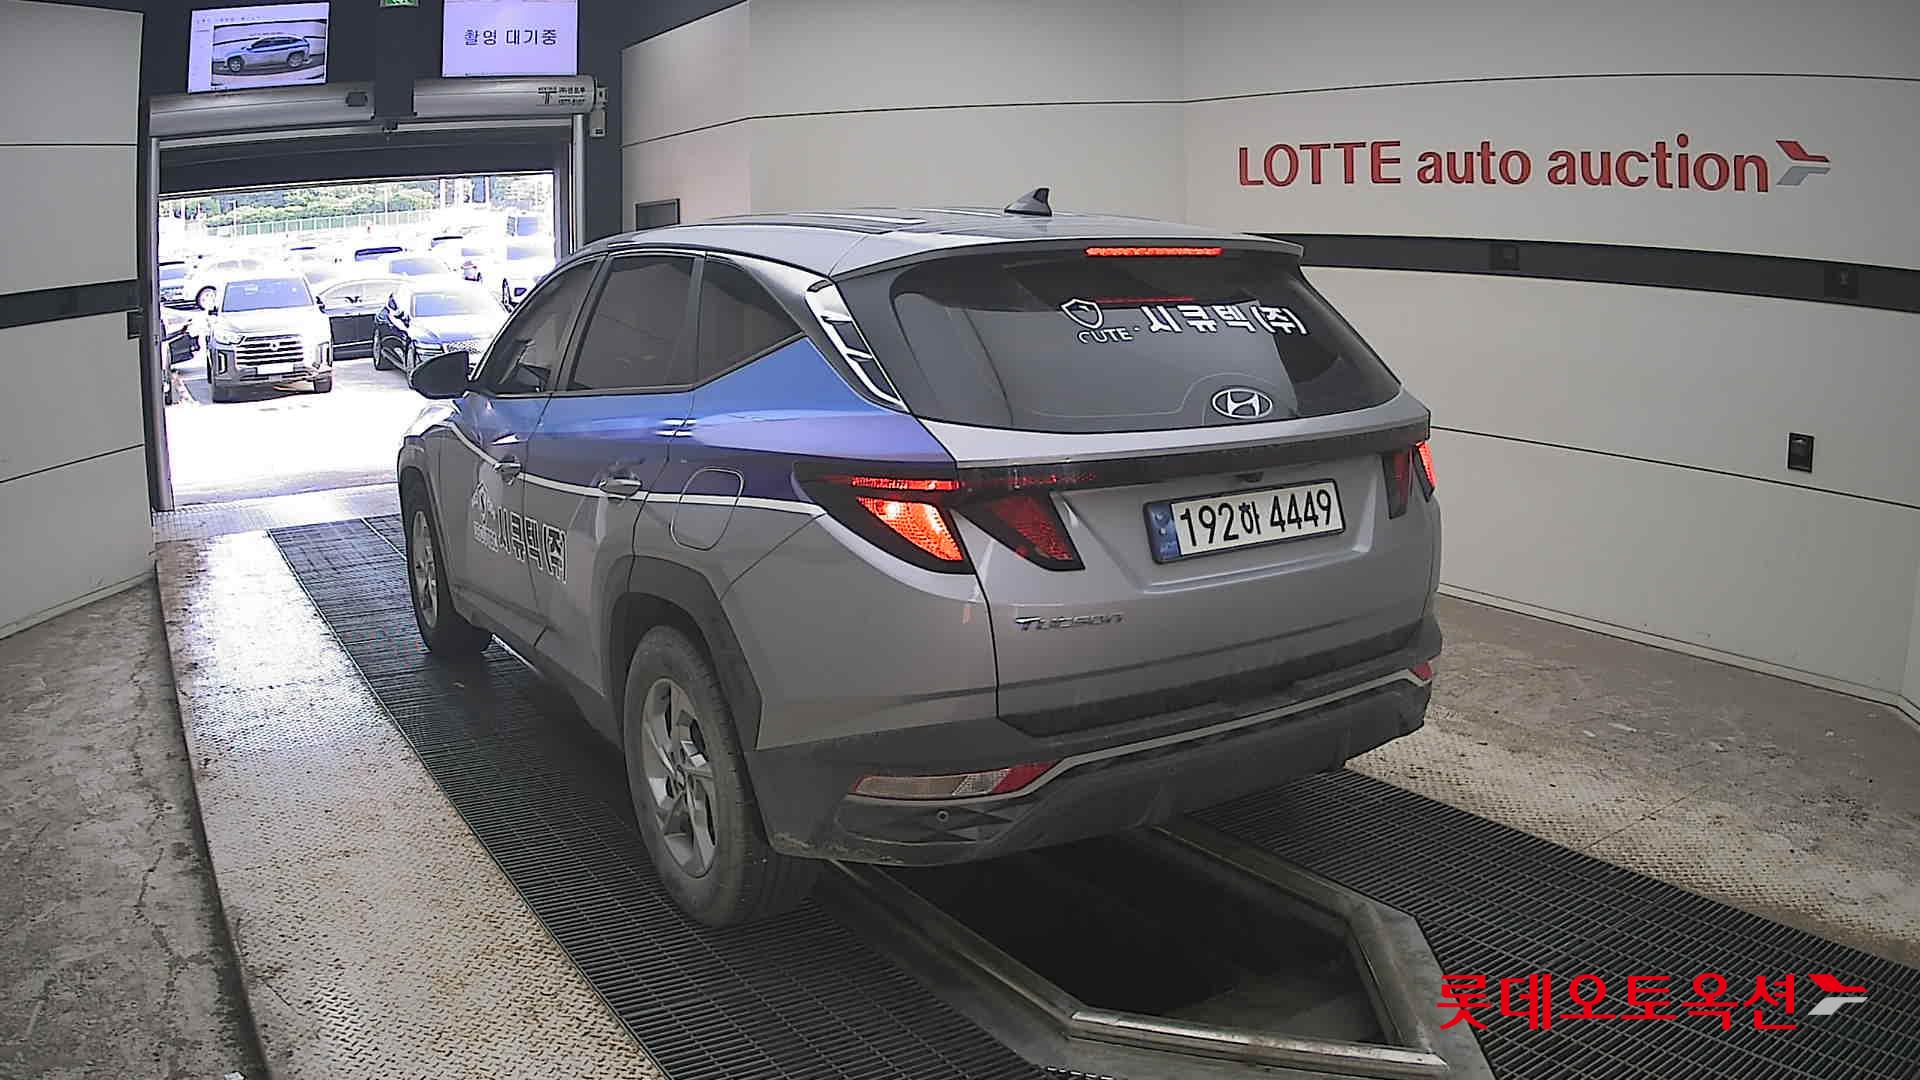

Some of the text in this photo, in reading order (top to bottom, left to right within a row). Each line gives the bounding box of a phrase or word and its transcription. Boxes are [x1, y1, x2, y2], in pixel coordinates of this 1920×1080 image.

[505, 29, 557, 46] 대기중
[1239, 134, 1770, 193] LOTTE auto auction
[1180, 489, 1332, 547] 192하 4449
